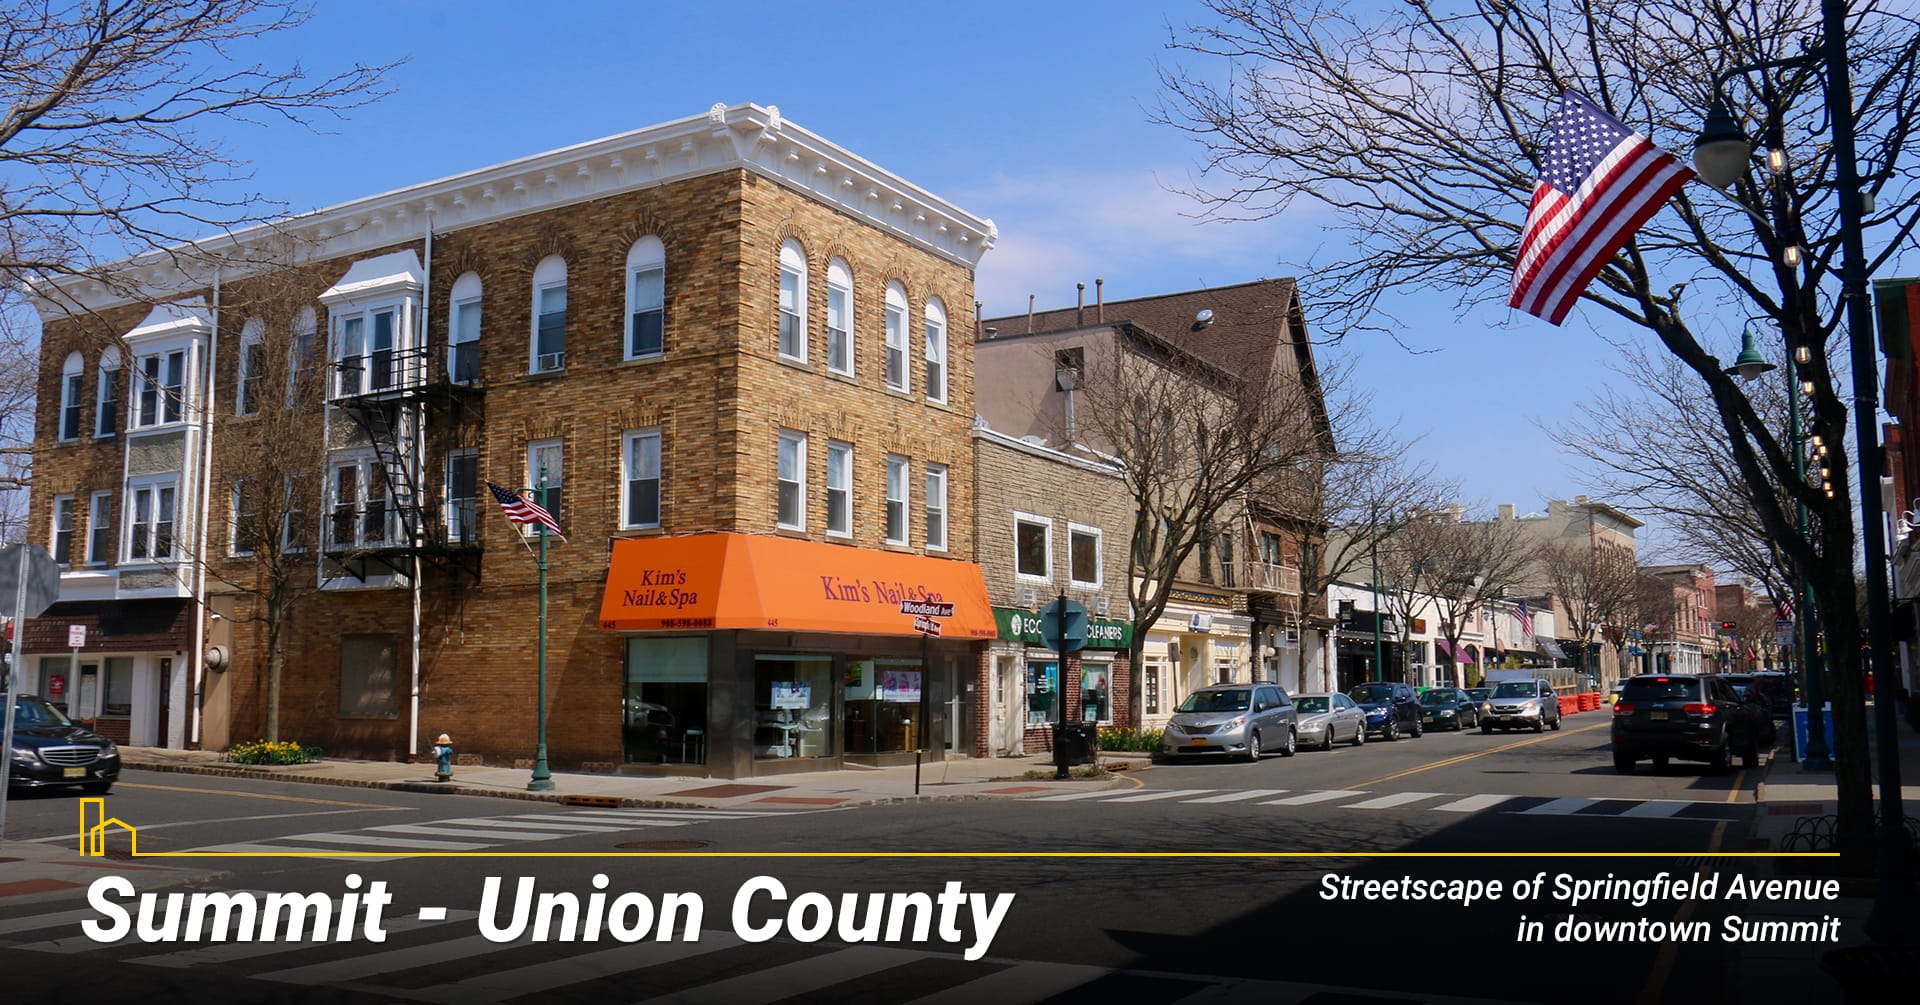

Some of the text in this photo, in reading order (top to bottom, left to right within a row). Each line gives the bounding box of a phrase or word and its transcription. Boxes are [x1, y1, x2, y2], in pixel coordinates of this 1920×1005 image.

[641, 569, 686, 586] Kim's
[820, 575, 871, 603] Kim's
[903, 601, 940, 615] Woodland
[1086, 624, 1123, 640] CLEANERS
